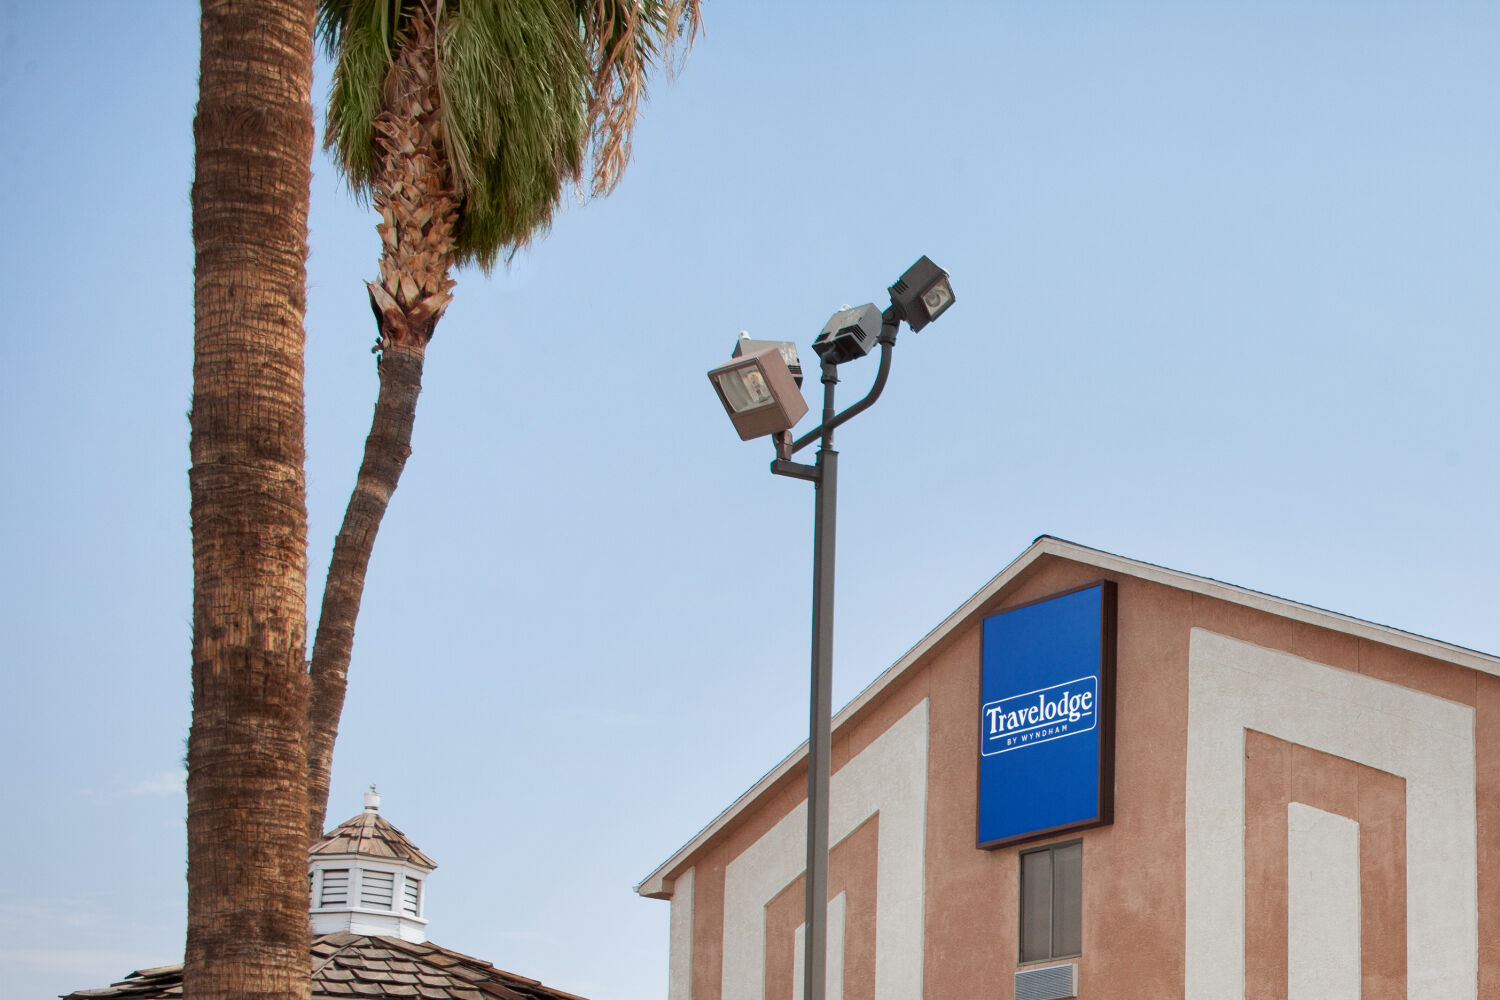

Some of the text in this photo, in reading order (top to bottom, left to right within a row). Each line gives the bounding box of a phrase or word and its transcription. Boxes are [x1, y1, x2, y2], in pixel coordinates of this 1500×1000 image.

[986, 691, 1093, 734] Travelodge
[1007, 724, 1068, 746] BY WYNDHAM
